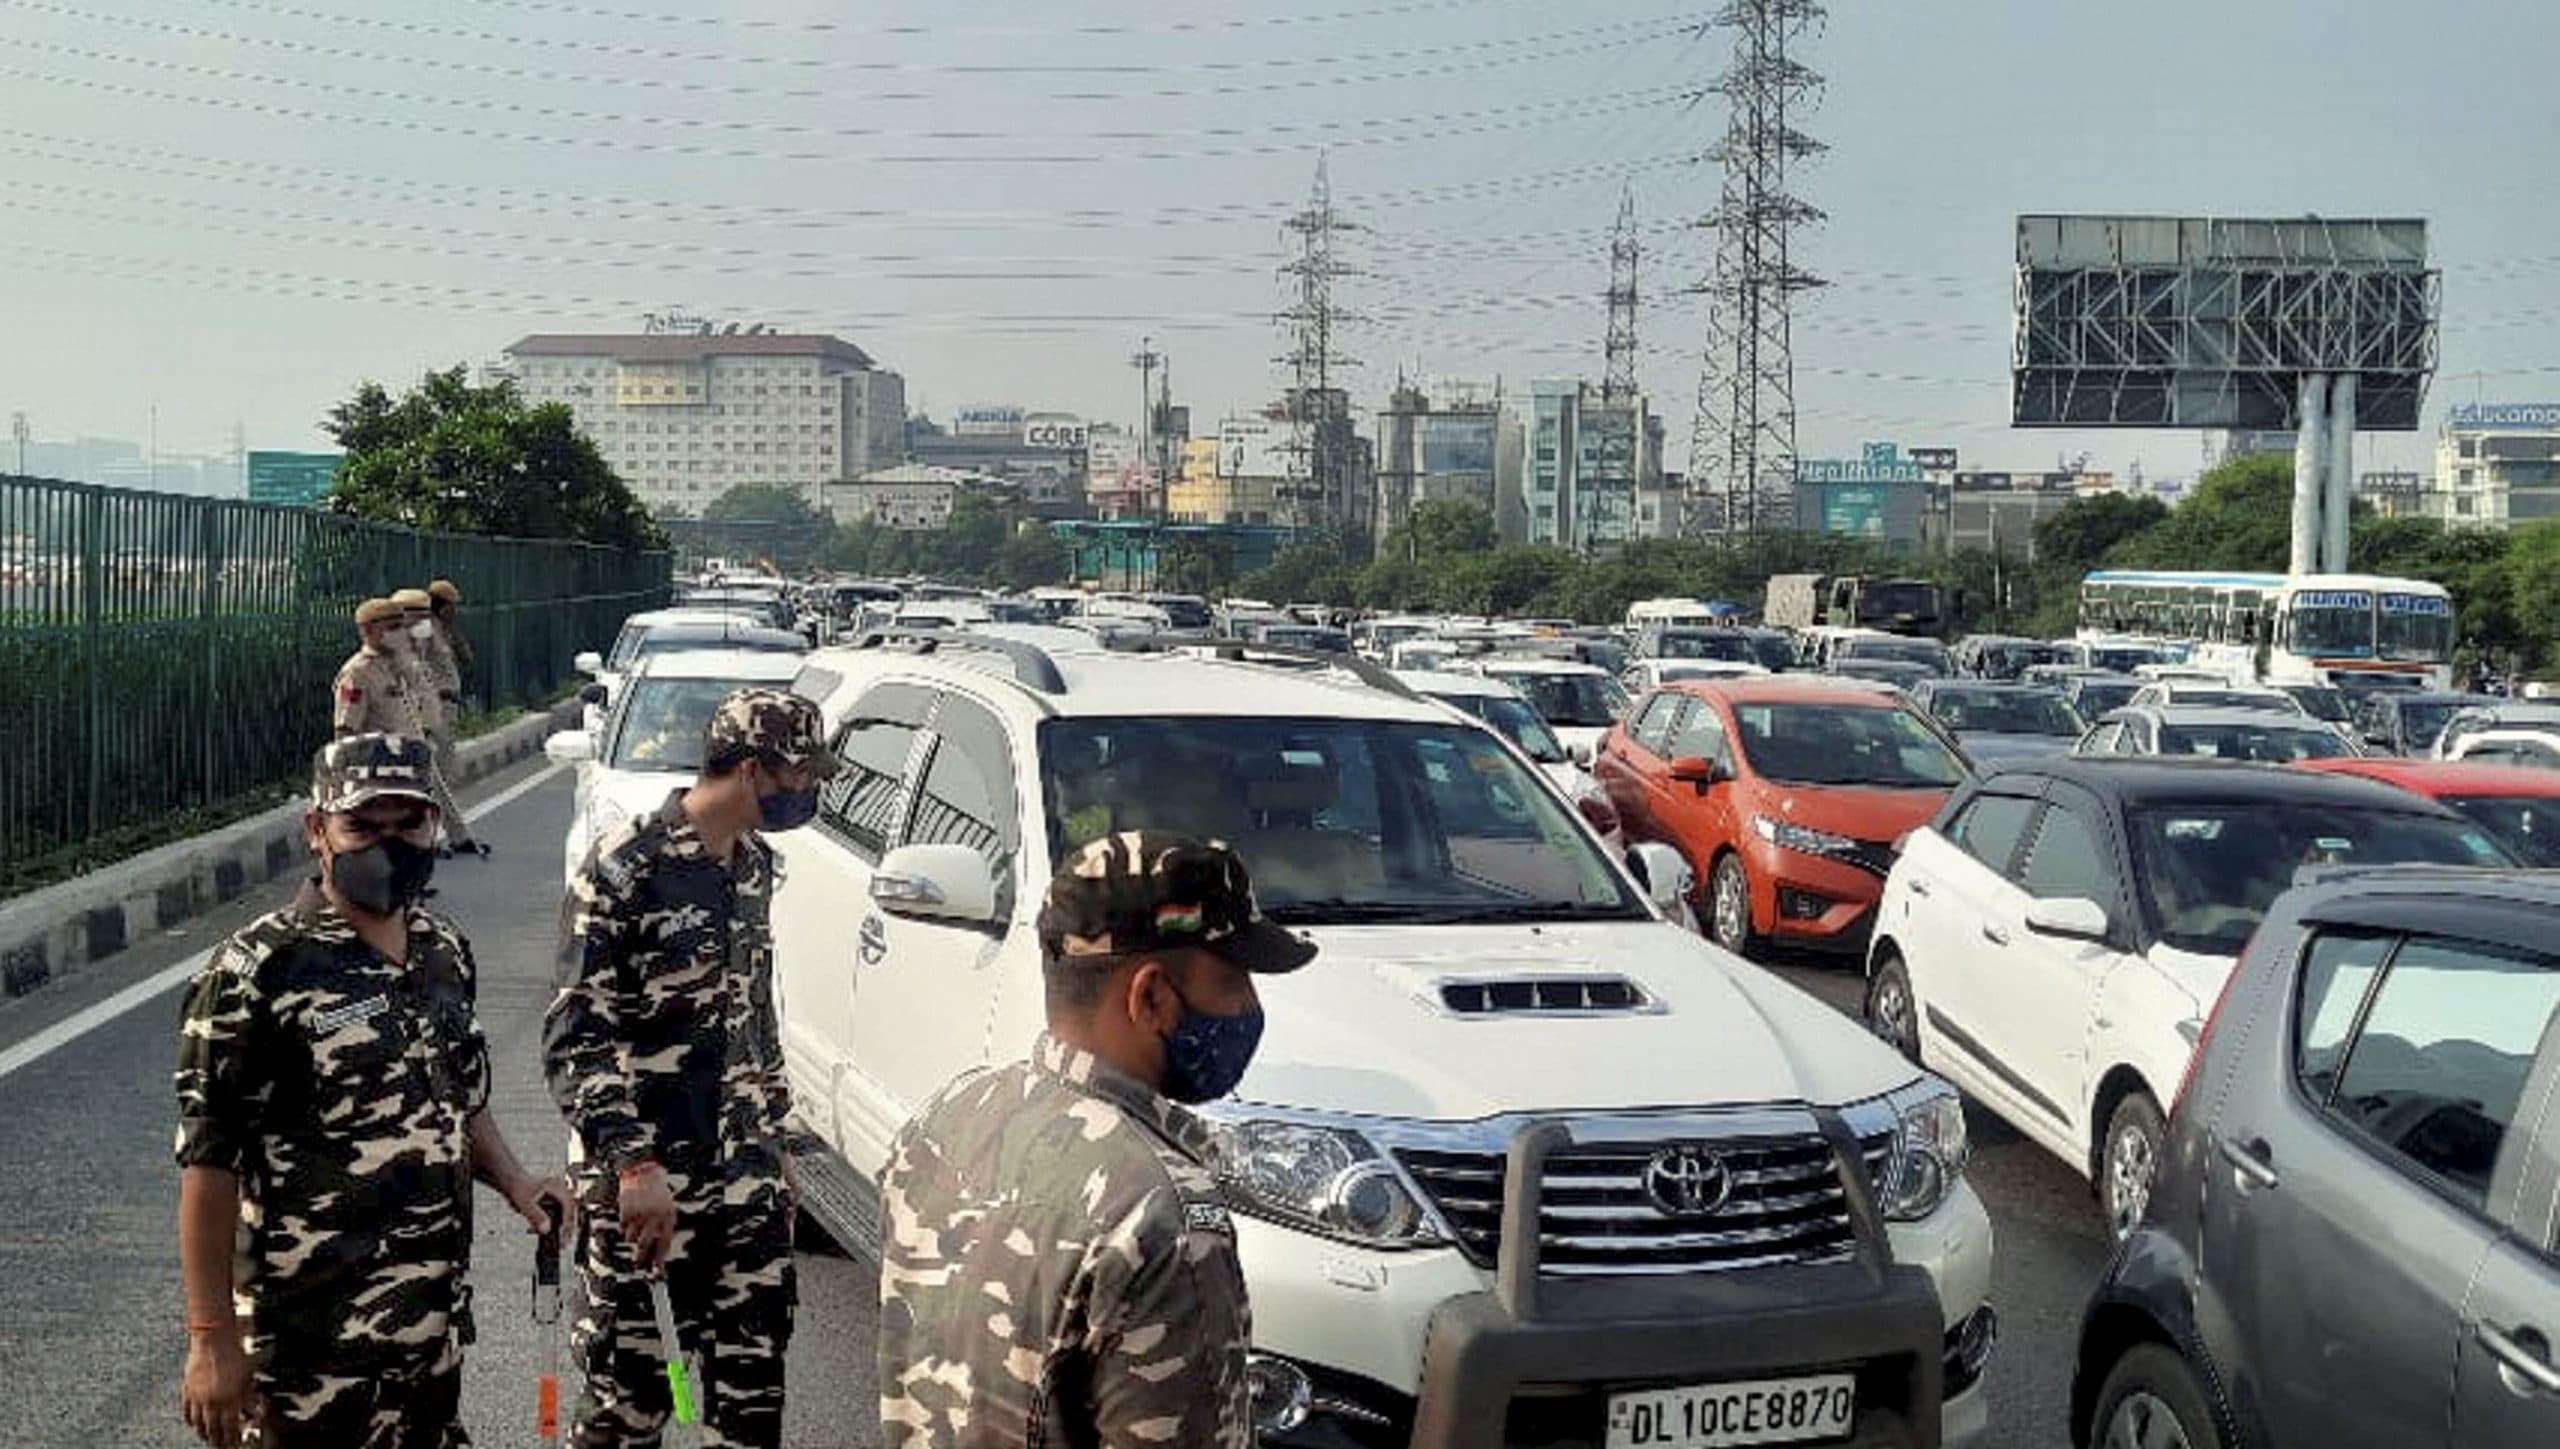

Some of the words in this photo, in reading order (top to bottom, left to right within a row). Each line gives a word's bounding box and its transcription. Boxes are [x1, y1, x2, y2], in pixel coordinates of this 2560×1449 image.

[1029, 426, 1086, 447] CORE
[1801, 460, 1918, 482] Healthians
[1632, 1387, 1850, 1444] DL10CE8870
